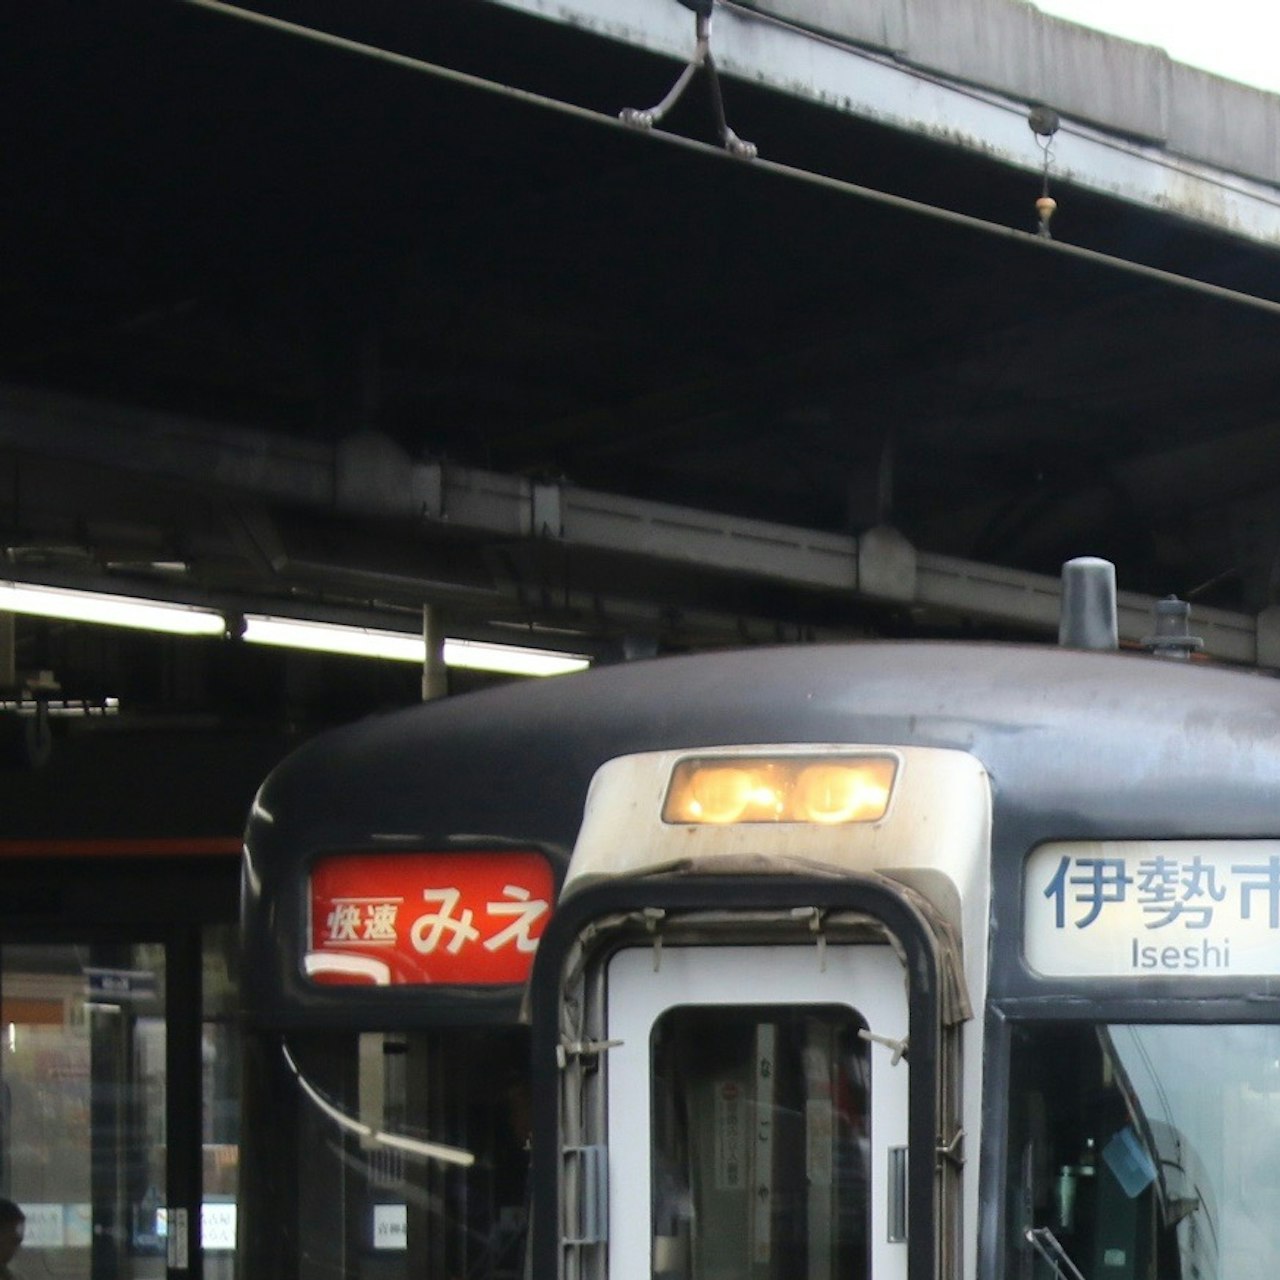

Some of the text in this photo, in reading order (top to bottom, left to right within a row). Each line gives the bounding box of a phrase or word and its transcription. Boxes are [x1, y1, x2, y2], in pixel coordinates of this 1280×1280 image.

[327, 885, 550, 955] 快速 みえ
[1132, 937, 1230, 969] Iseshi
